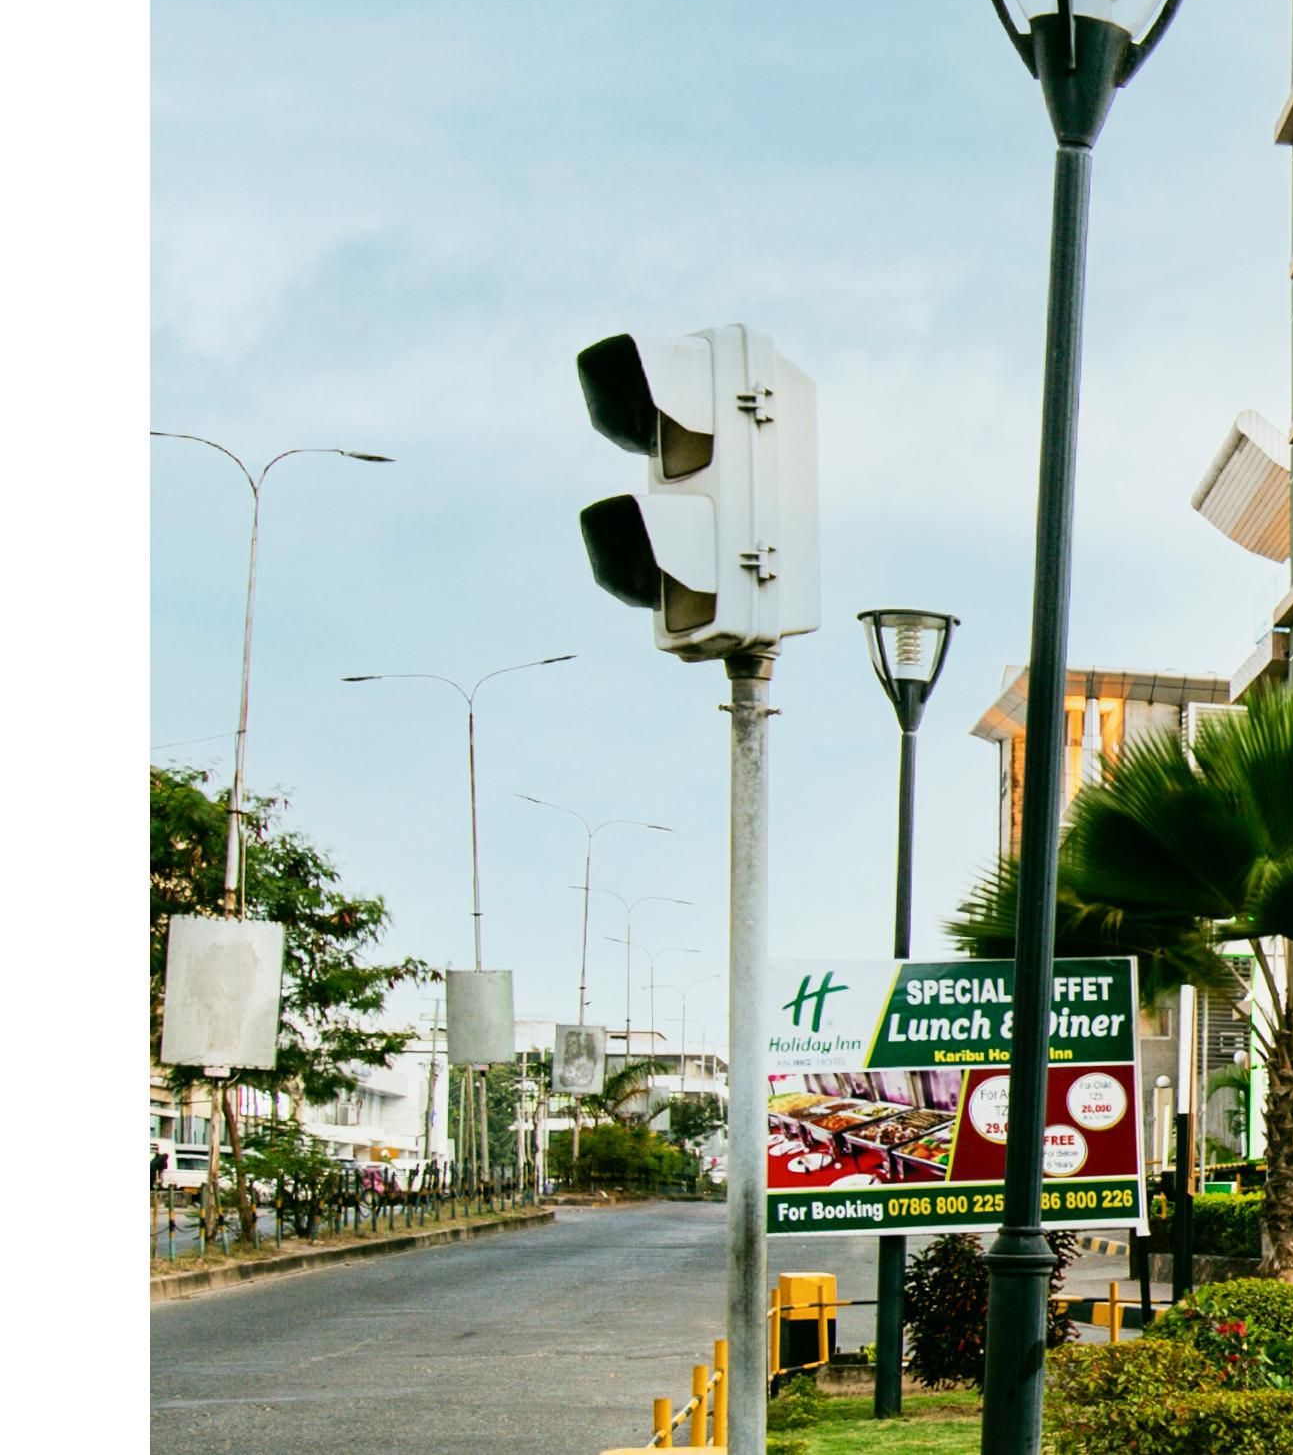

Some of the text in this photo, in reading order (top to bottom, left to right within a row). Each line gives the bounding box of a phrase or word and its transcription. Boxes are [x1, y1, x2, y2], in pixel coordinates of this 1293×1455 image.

[906, 976, 1113, 1005] SPECIAL FFET
[888, 1009, 991, 1042] Lunch
[768, 1035, 861, 1054] Holiday Inn
[934, 1049, 984, 1062] Karibu
[980, 1090, 998, 1100] For
[994, 1105, 1009, 1116] TZ
[1044, 1134, 1075, 1146] FREE
[777, 1189, 1133, 1221] For Booking 0786 800 225 86 800 226
